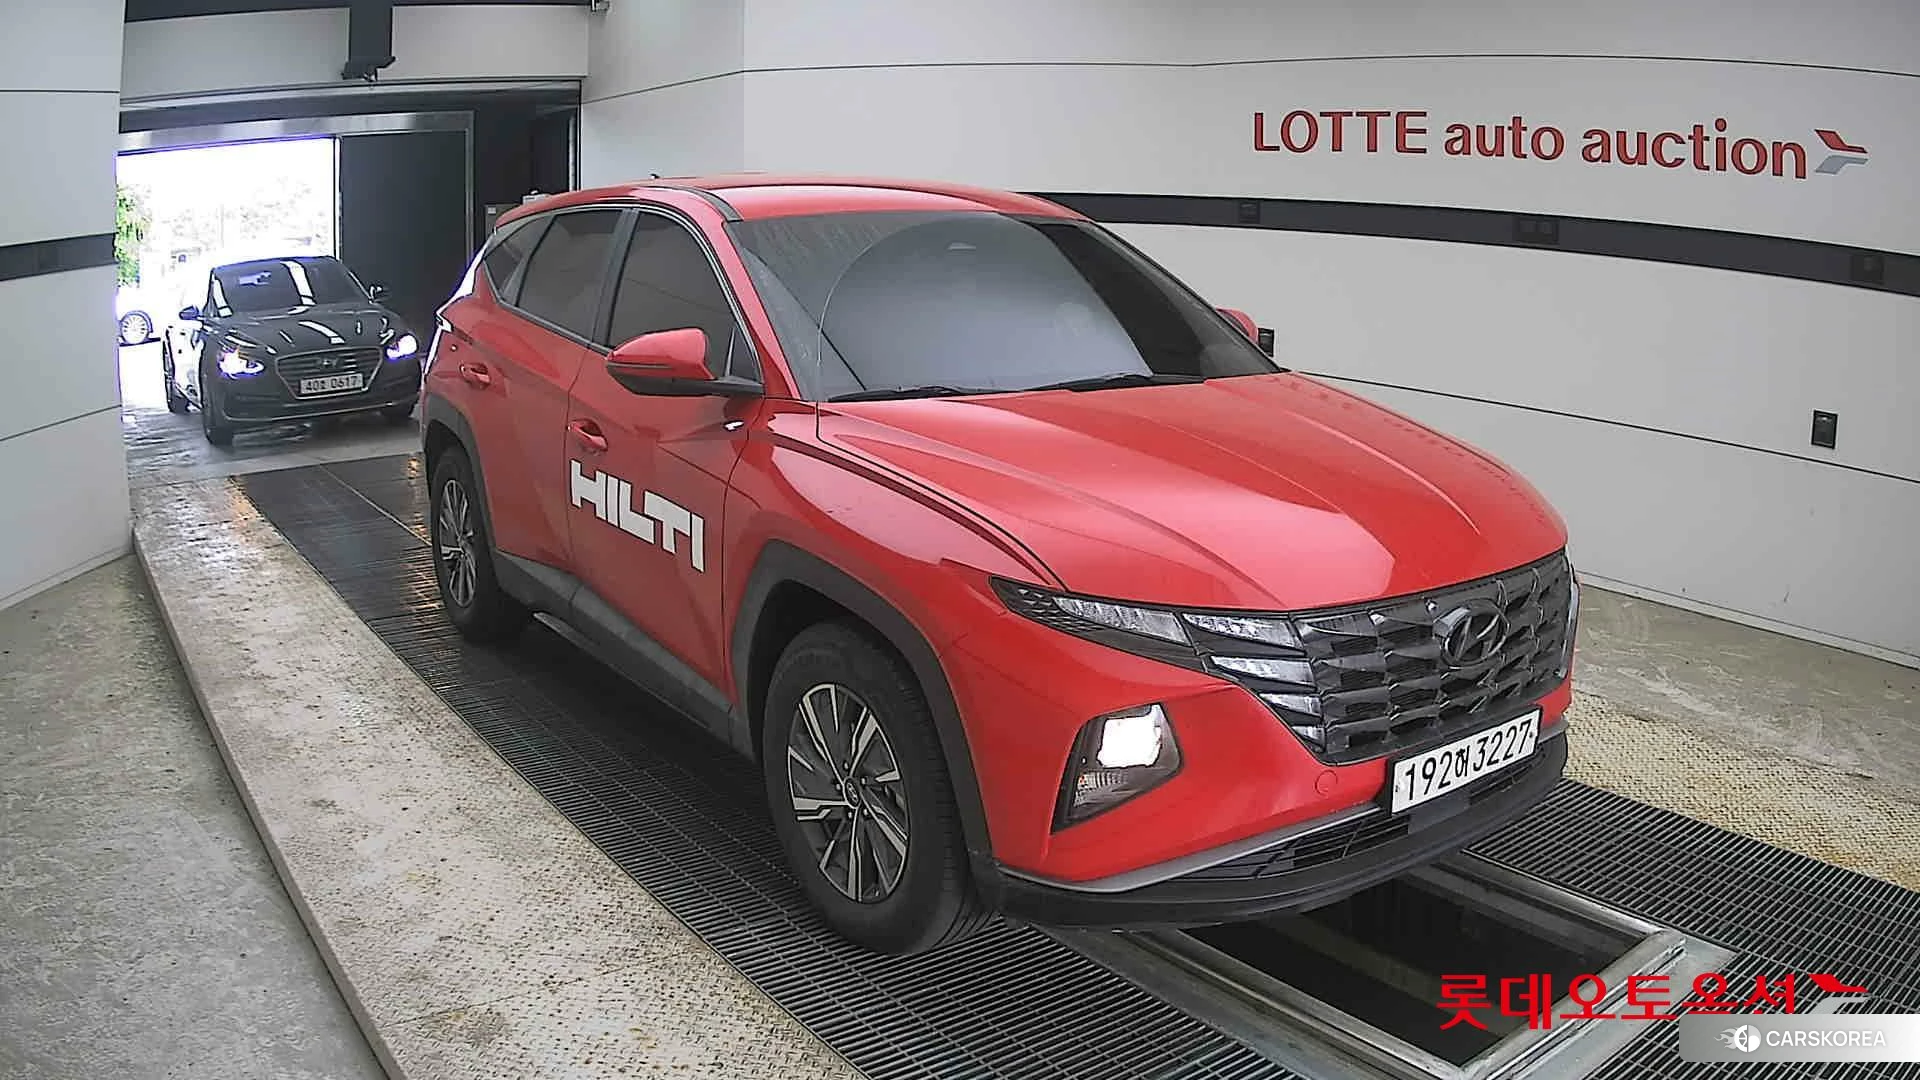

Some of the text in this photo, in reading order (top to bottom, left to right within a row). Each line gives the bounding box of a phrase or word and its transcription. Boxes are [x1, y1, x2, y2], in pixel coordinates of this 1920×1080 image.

[1253, 111, 1807, 179] LOTTE auto auction
[570, 459, 705, 573] HILTI
